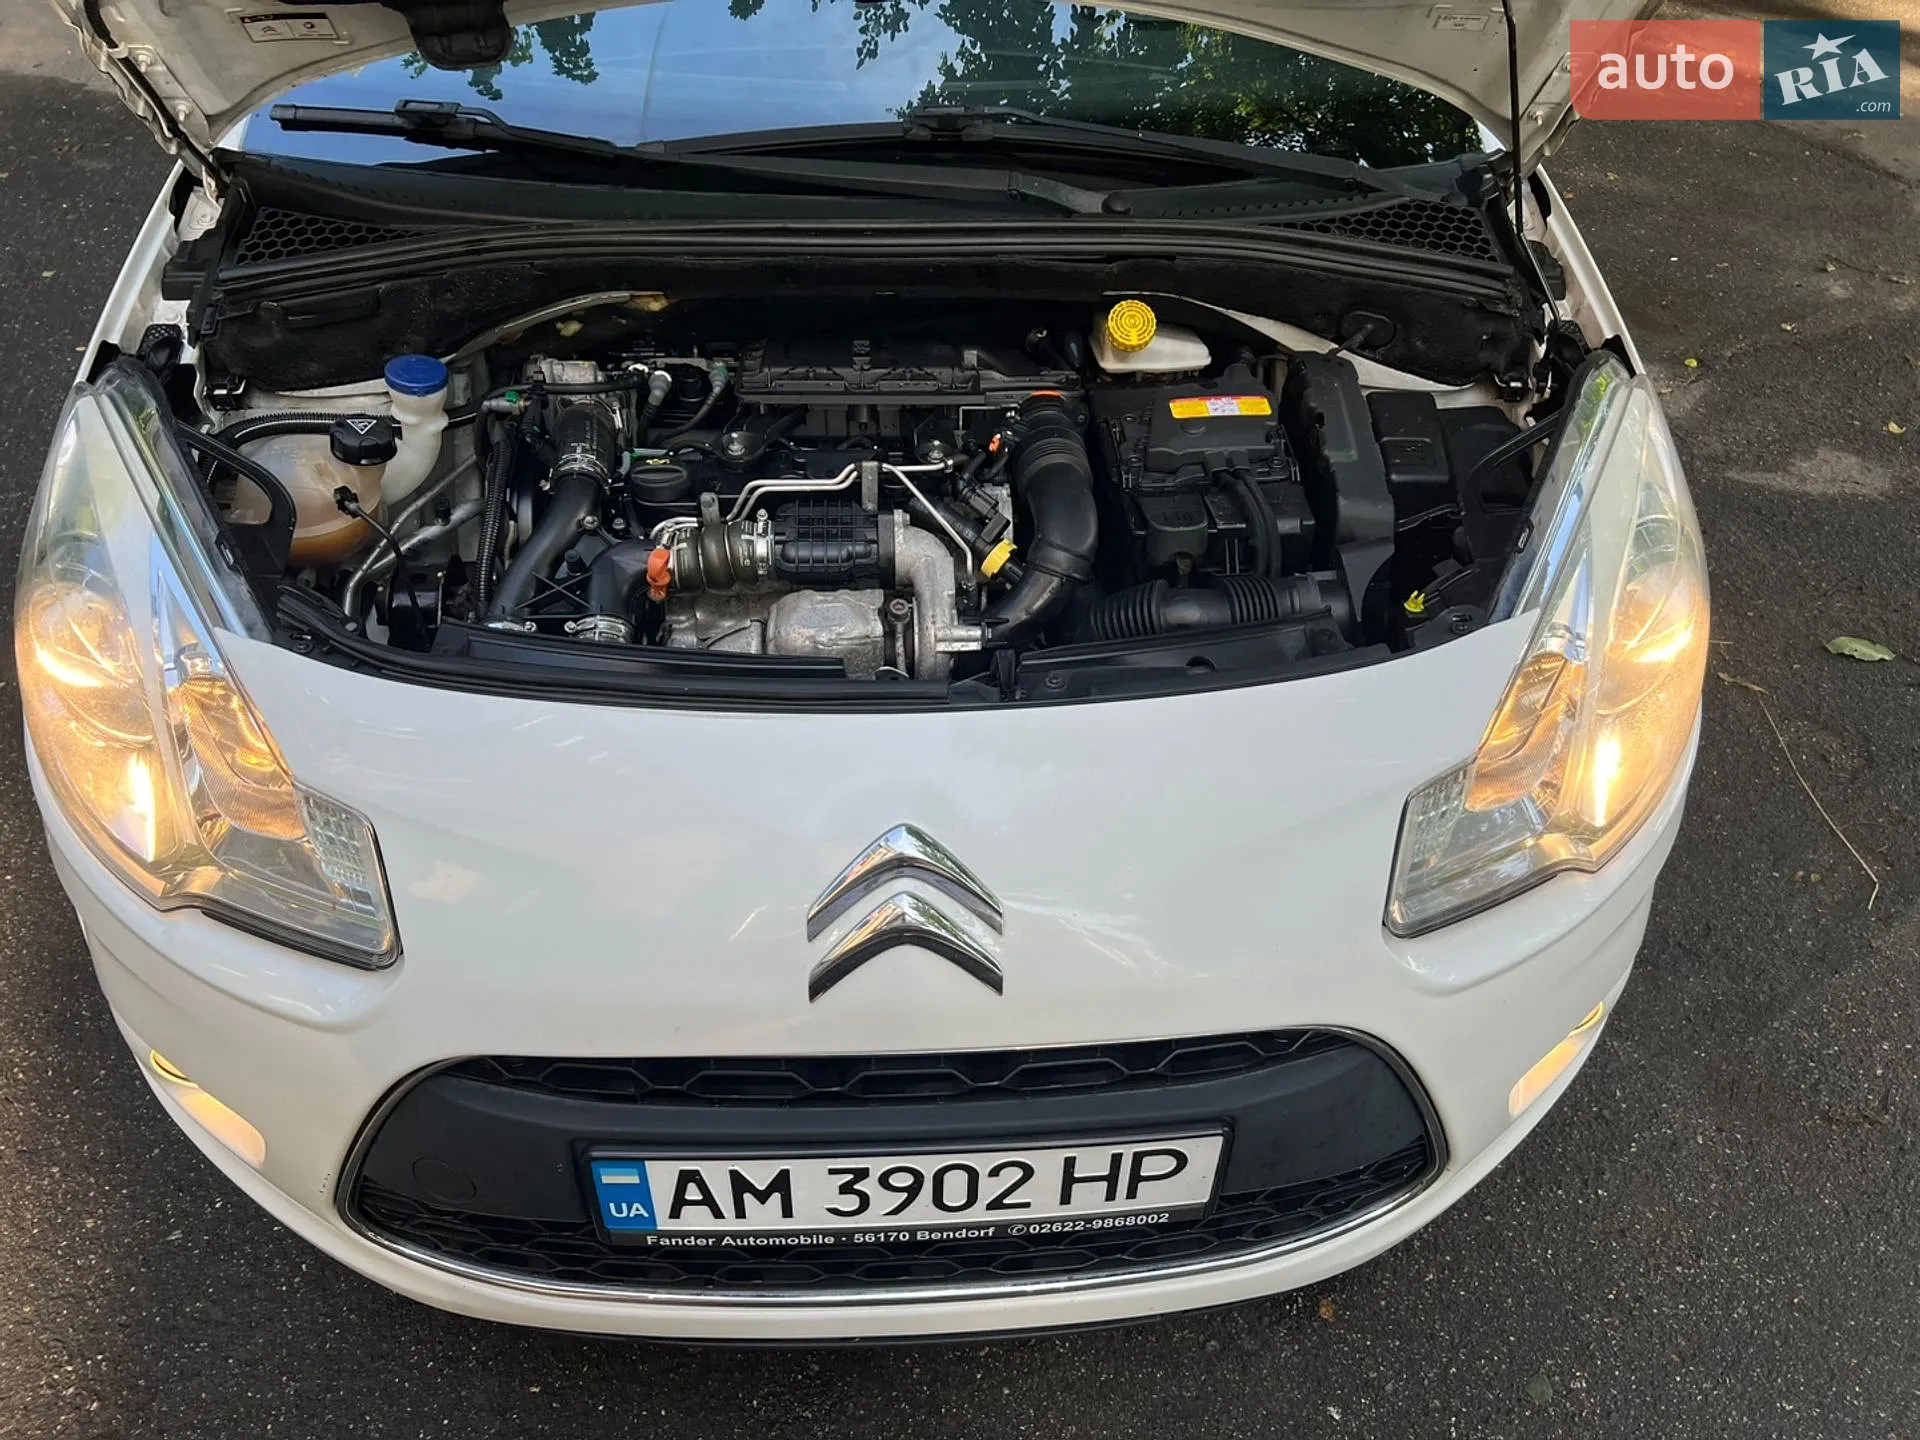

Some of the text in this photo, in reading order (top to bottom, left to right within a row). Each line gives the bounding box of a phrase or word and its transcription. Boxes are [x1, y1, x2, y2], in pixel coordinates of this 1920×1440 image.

[667, 1148, 1189, 1220] AM 3902 HP
[608, 1201, 649, 1218] UA
[646, 1212, 1170, 1247] Fander Automobile 56170 Bendorf 02622-9868002
